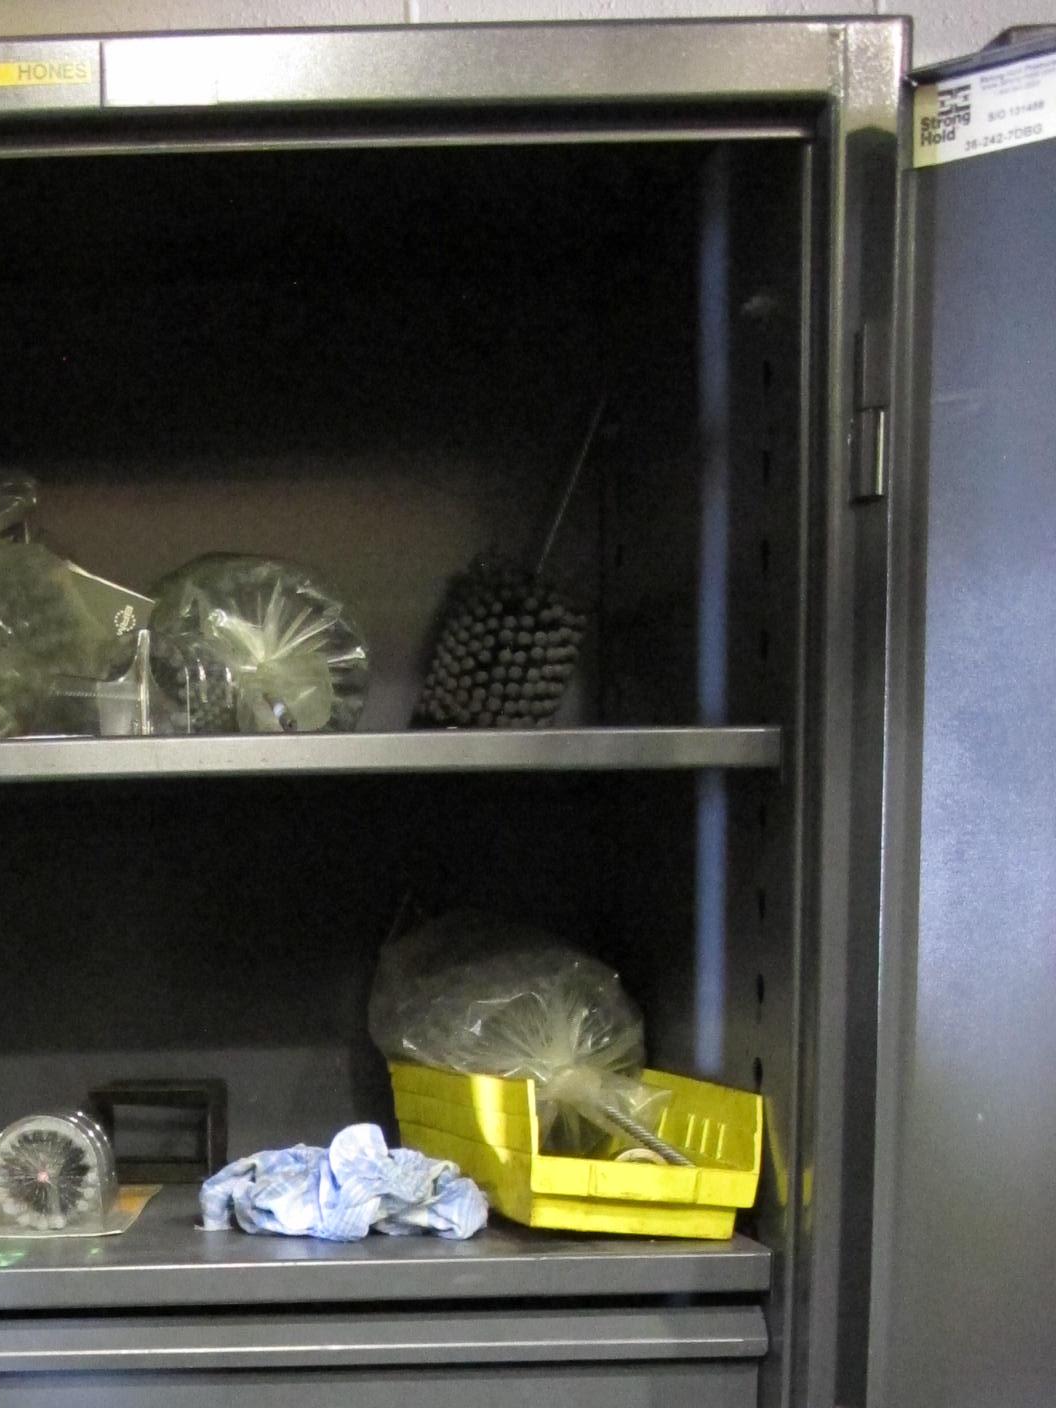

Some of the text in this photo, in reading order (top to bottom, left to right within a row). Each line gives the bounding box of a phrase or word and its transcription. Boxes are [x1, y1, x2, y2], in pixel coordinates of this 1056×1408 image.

[17, 63, 87, 80] HONES
[920, 111, 971, 131] Strong
[920, 128, 956, 147] Hold
